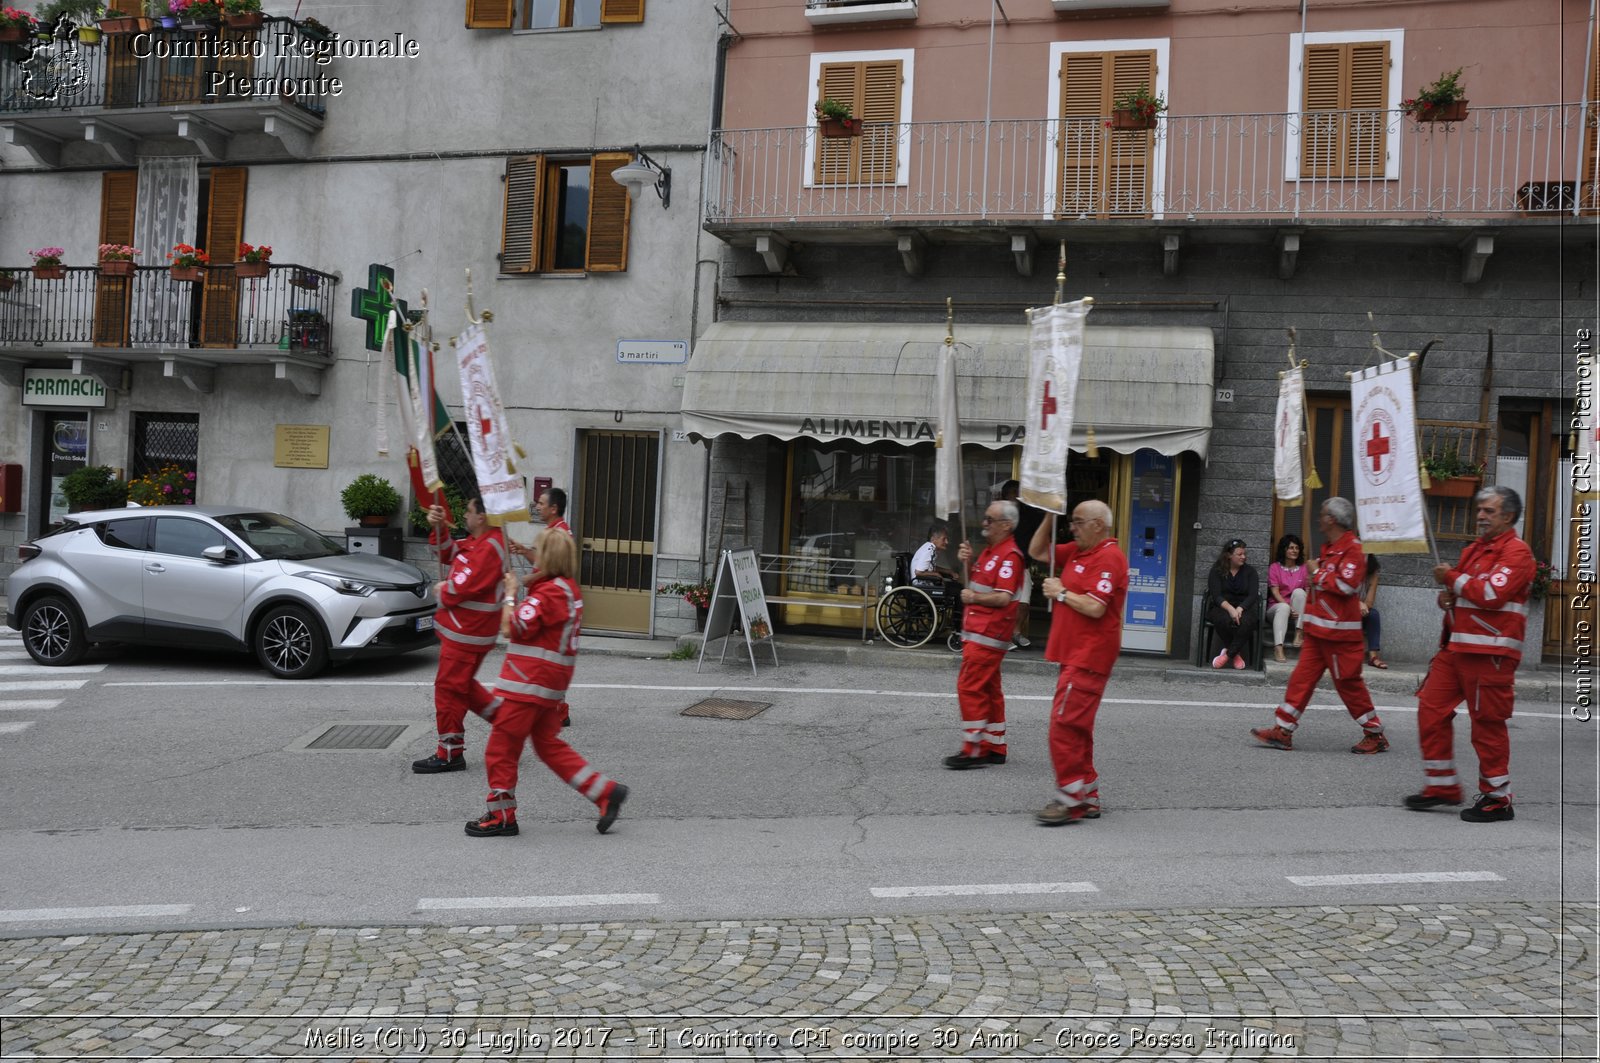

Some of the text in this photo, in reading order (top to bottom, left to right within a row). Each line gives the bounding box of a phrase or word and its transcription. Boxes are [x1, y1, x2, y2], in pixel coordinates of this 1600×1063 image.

[619, 351, 659, 359] 3 martiri
[25, 378, 104, 396] FARMACIA
[1219, 391, 1231, 400] 70
[798, 417, 1026, 443] ALIMENTA PA
[675, 431, 685, 440] 72
